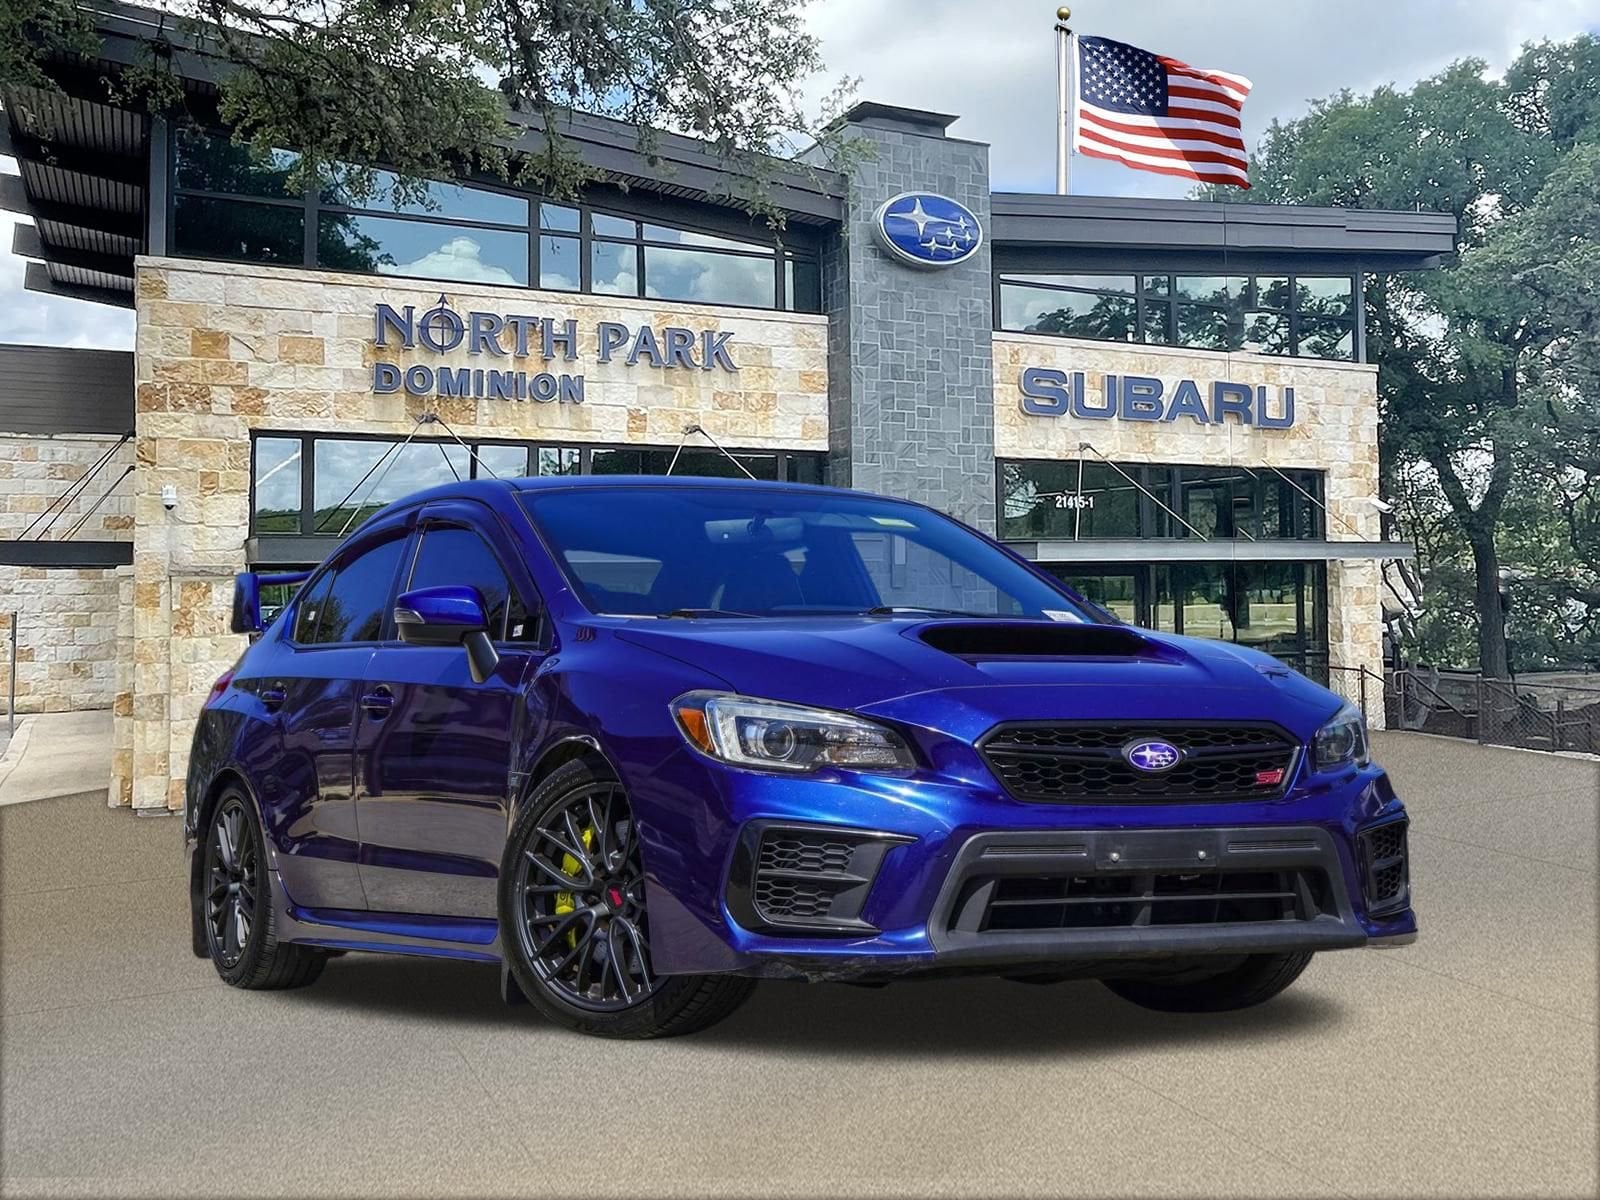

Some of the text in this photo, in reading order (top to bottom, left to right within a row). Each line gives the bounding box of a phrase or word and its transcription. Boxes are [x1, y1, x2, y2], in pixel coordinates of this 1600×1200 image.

[374, 303, 741, 373] NORTH PARK
[373, 362, 585, 404] DOMINION
[1018, 367, 1295, 430] SUBARU
